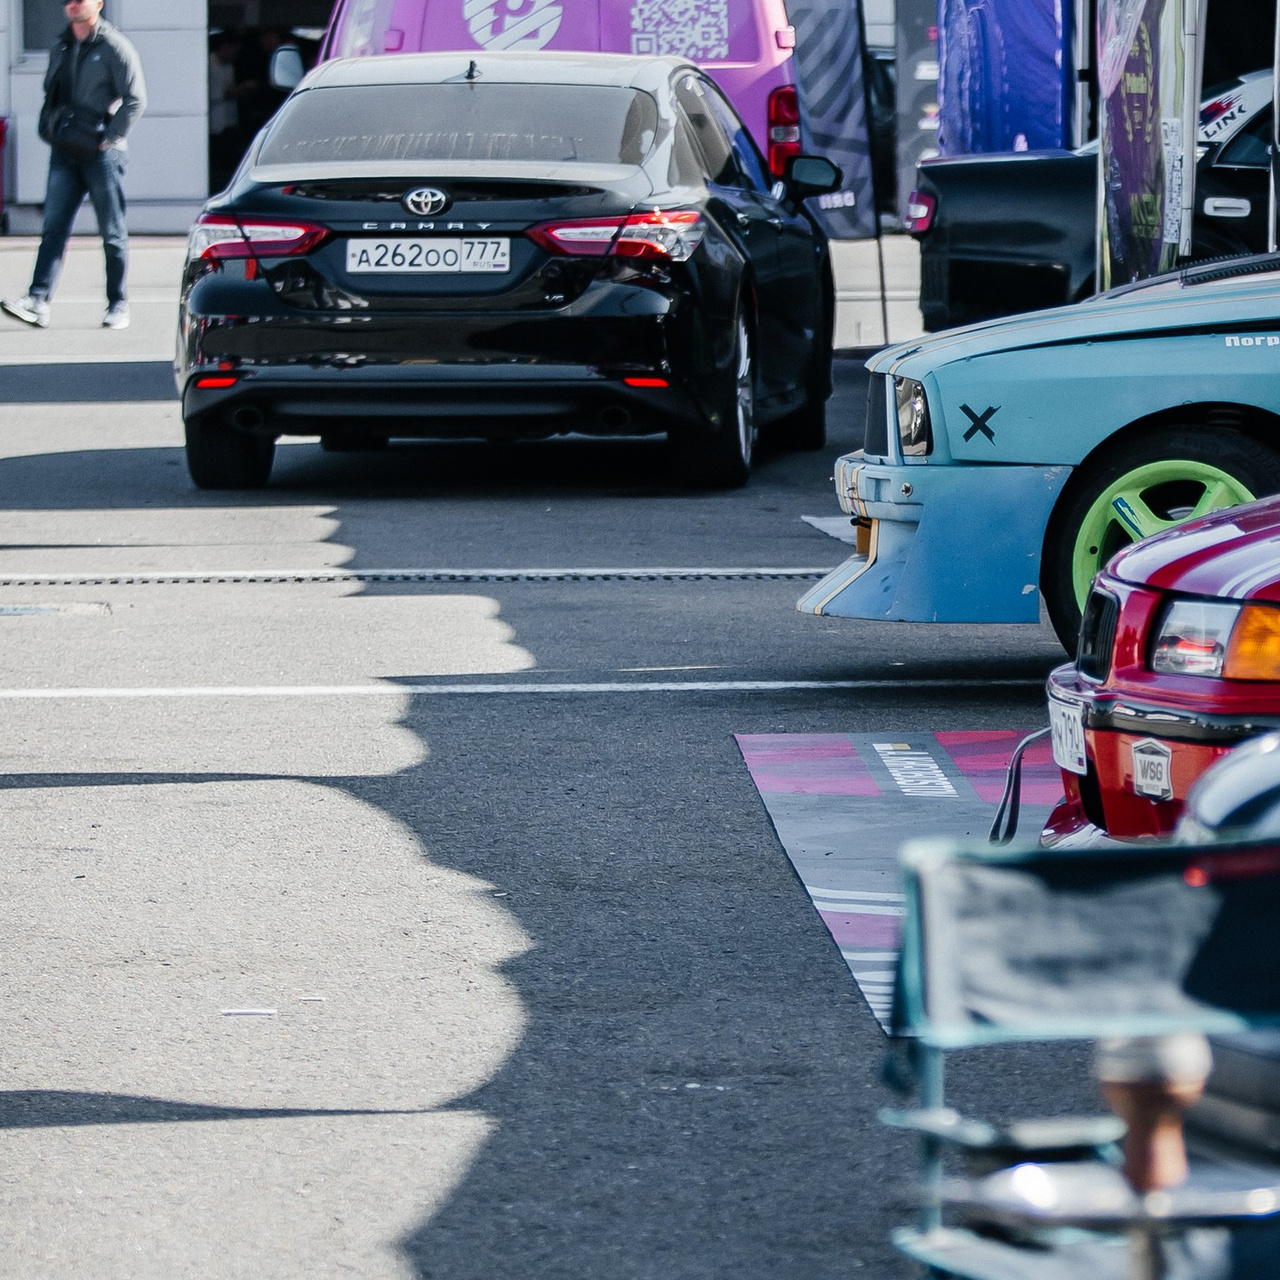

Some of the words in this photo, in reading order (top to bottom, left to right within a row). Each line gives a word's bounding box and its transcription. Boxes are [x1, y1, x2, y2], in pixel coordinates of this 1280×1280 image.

[362, 222, 491, 230] CAMRY
[464, 241, 501, 260] 777
[1140, 759, 1163, 781] WSG
